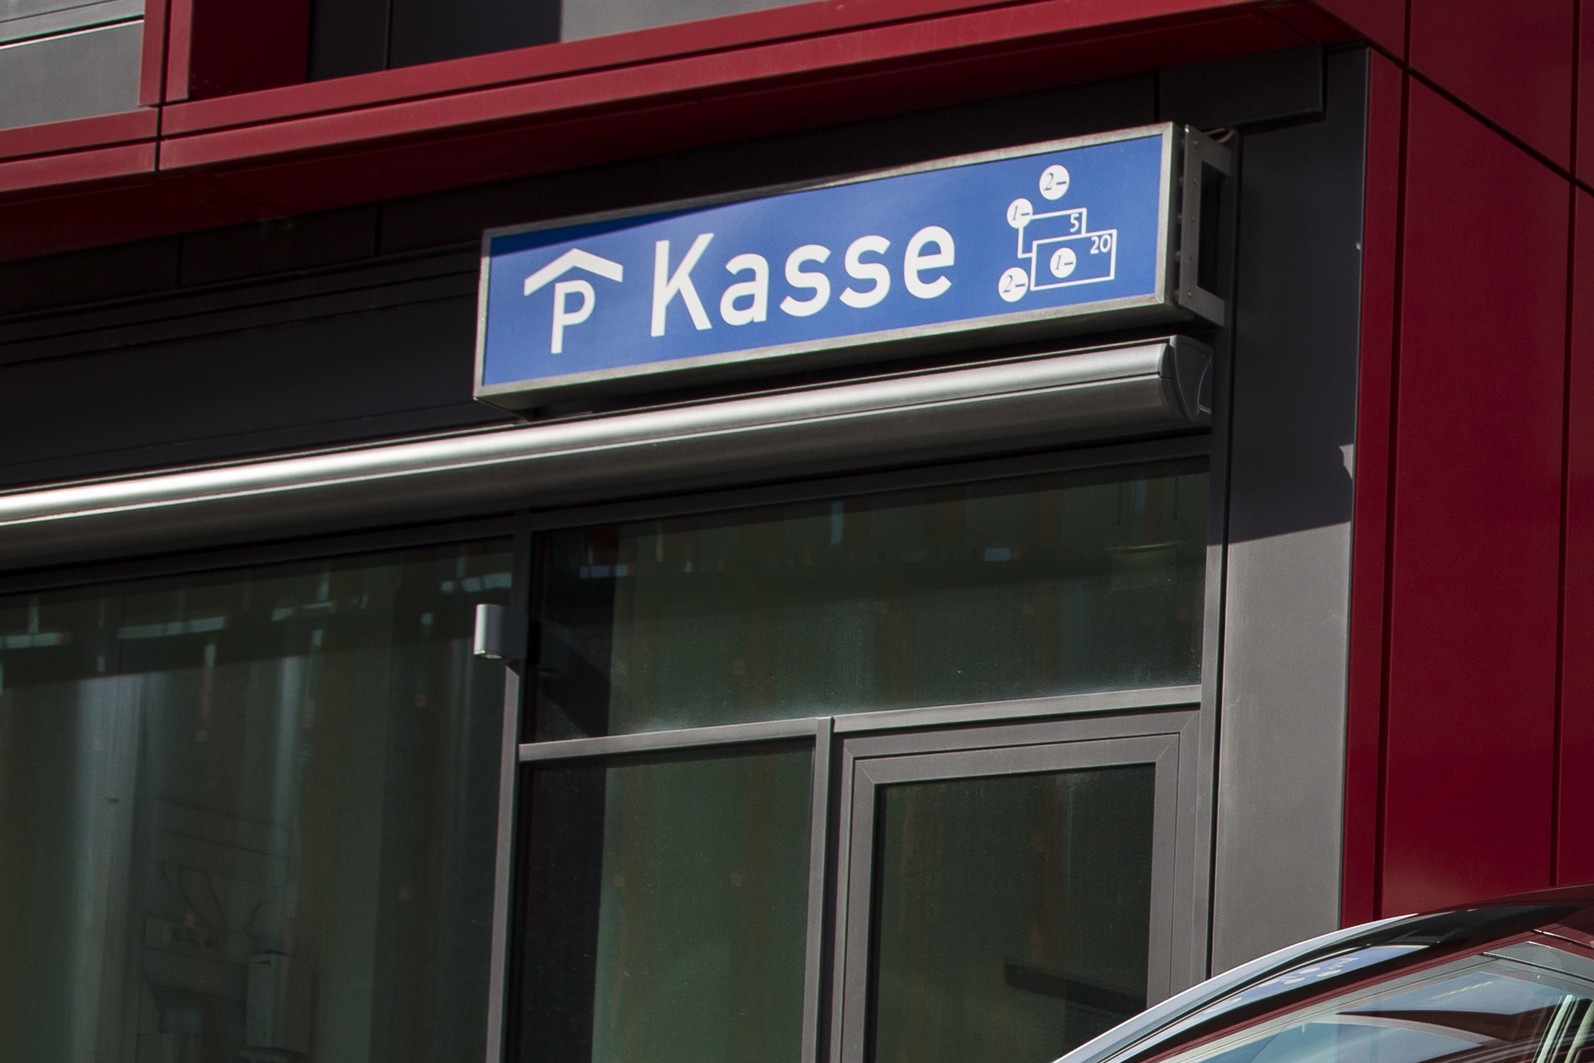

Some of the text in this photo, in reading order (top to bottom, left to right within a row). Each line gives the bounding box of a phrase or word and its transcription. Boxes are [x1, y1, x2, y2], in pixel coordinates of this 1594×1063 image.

[1069, 212, 1081, 233] 5
[1089, 233, 1112, 255] 20
[551, 225, 956, 354] P Kasse
